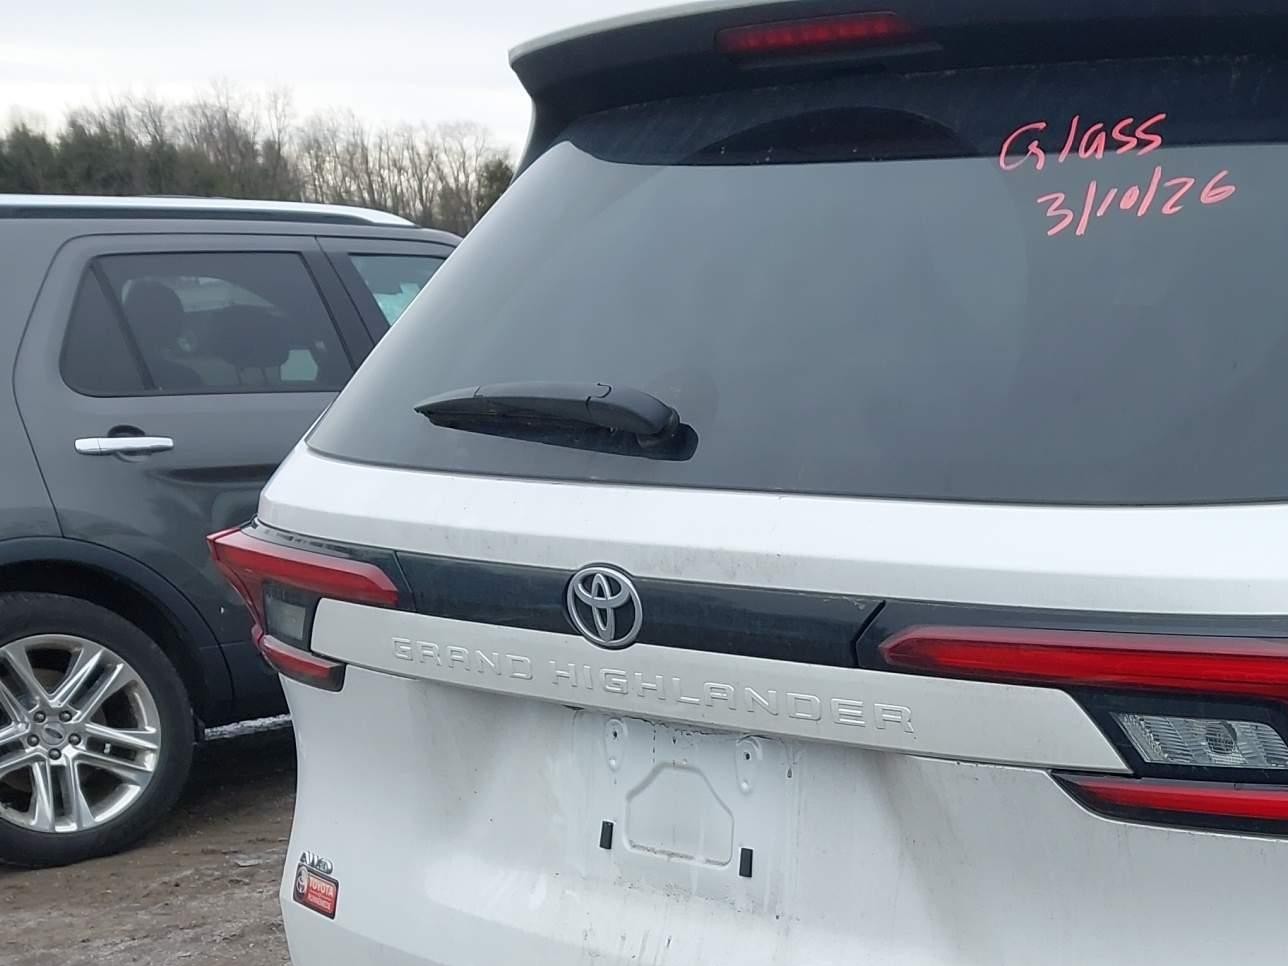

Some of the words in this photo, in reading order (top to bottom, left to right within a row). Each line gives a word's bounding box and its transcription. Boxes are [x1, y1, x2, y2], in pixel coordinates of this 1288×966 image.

[999, 112, 1167, 171] Glass
[1036, 165, 1237, 236] 3/10/26
[391, 636, 534, 681] GRAND
[548, 659, 917, 735] HIGHLANDER
